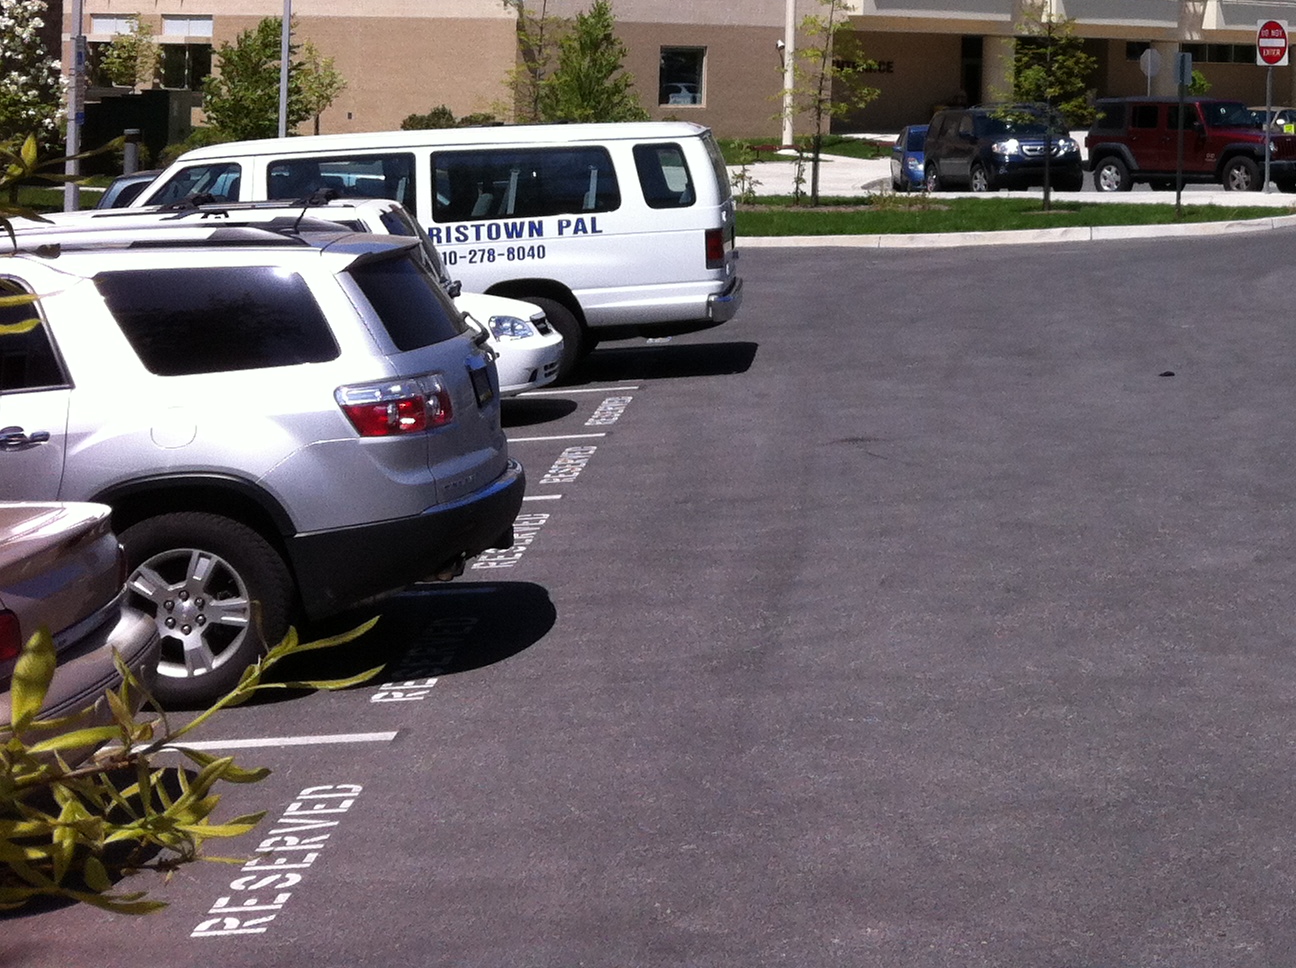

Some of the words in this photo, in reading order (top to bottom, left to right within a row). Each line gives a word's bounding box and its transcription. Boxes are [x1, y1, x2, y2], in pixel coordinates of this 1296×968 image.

[1261, 29, 1270, 37] DO
[1271, 29, 1283, 37] NOT
[1263, 48, 1281, 57] ENTER
[427, 220, 544, 244] RISTOWN
[557, 216, 604, 236] PAL
[442, 244, 546, 266] 10-278-8040
[584, 396, 634, 426] RESERVED
[538, 445, 598, 484] RESERVED
[189, 783, 364, 938] RESERVED
